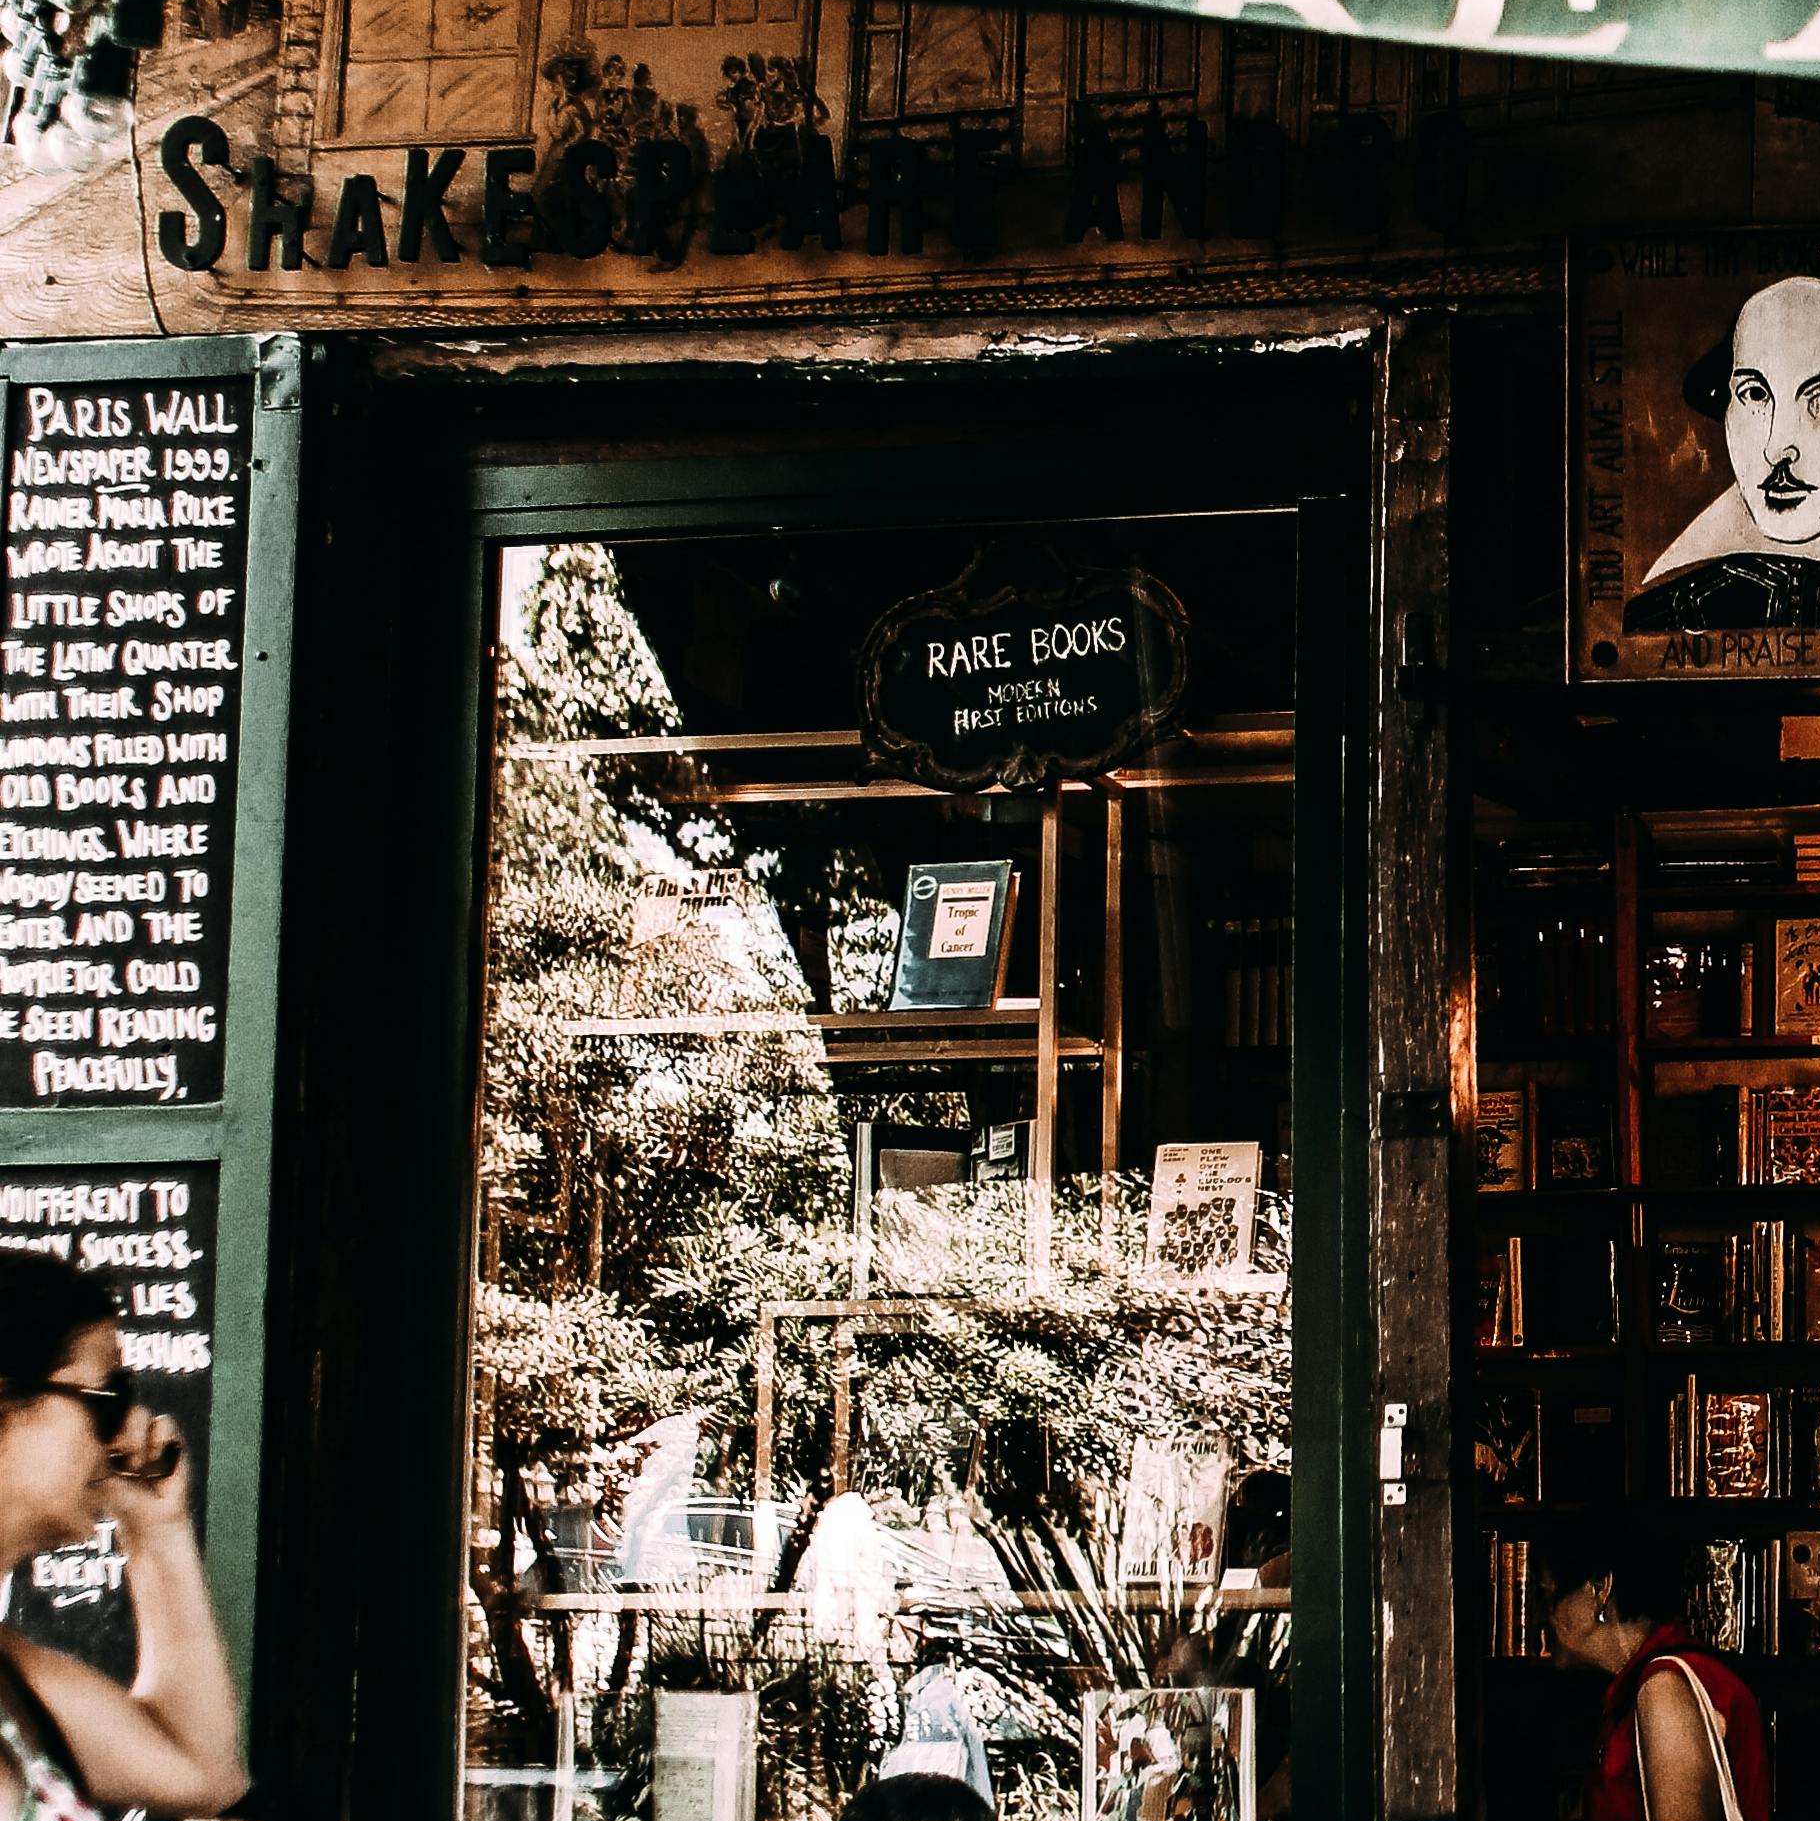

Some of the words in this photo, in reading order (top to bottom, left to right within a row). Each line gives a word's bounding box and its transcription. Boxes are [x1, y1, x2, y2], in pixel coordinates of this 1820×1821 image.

[1589, 310, 1623, 385] STILL
[26, 387, 132, 442] PARIS
[144, 391, 238, 436] WALL
[1589, 398, 1623, 474] ALIVE
[12, 446, 157, 486] NEWSPAPER
[163, 448, 239, 481] 1999.
[8, 491, 97, 532] RAINER
[97, 495, 169, 529] MARIA
[172, 491, 236, 528] RILKE
[1589, 487, 1623, 541] ART
[6, 540, 83, 579] WROTE
[86, 532, 165, 572] ABOUT
[171, 538, 223, 573] THE
[1589, 546, 1623, 608] THOU
[11, 592, 101, 630] LITTLE
[105, 590, 185, 628] SHOPS
[197, 588, 236, 616] OF
[0, 640, 46, 677] THE
[52, 640, 118, 681] LATIN
[124, 639, 239, 677] QUARTER
[926, 632, 1012, 679] RARE
[1030, 616, 1127, 666] BOOKS
[1660, 632, 1712, 670] AND
[1721, 630, 1815, 666] PRAISE
[0, 690, 58, 722] WITH
[62, 686, 142, 720] THEIR
[150, 681, 224, 722] SHOP
[988, 678, 1061, 705] MODERN
[953, 706, 1004, 735] FIRST
[1016, 696, 1099, 724] EDITIONS
[94, 732, 164, 767] FILLED
[166, 733, 228, 764] WITH
[0, 774, 50, 809] OLD
[54, 774, 147, 812] BOOKS
[155, 775, 216, 808] AND
[114, 819, 209, 860] WHERE
[74, 869, 166, 905] SEEMED
[174, 869, 209, 904] TO
[74, 912, 135, 948] AND
[140, 912, 204, 944] THE
[948, 906, 980, 919] Tropic
[955, 925, 968, 936] of
[941, 941, 975, 953] Cancer
[125, 959, 201, 997] COULD
[22, 1006, 92, 1043] SEEN
[98, 1006, 218, 1047] READING
[149, 1181, 190, 1223] TO
[80, 1230, 204, 1272] SUCCESS.
[132, 1280, 199, 1319] LIES
